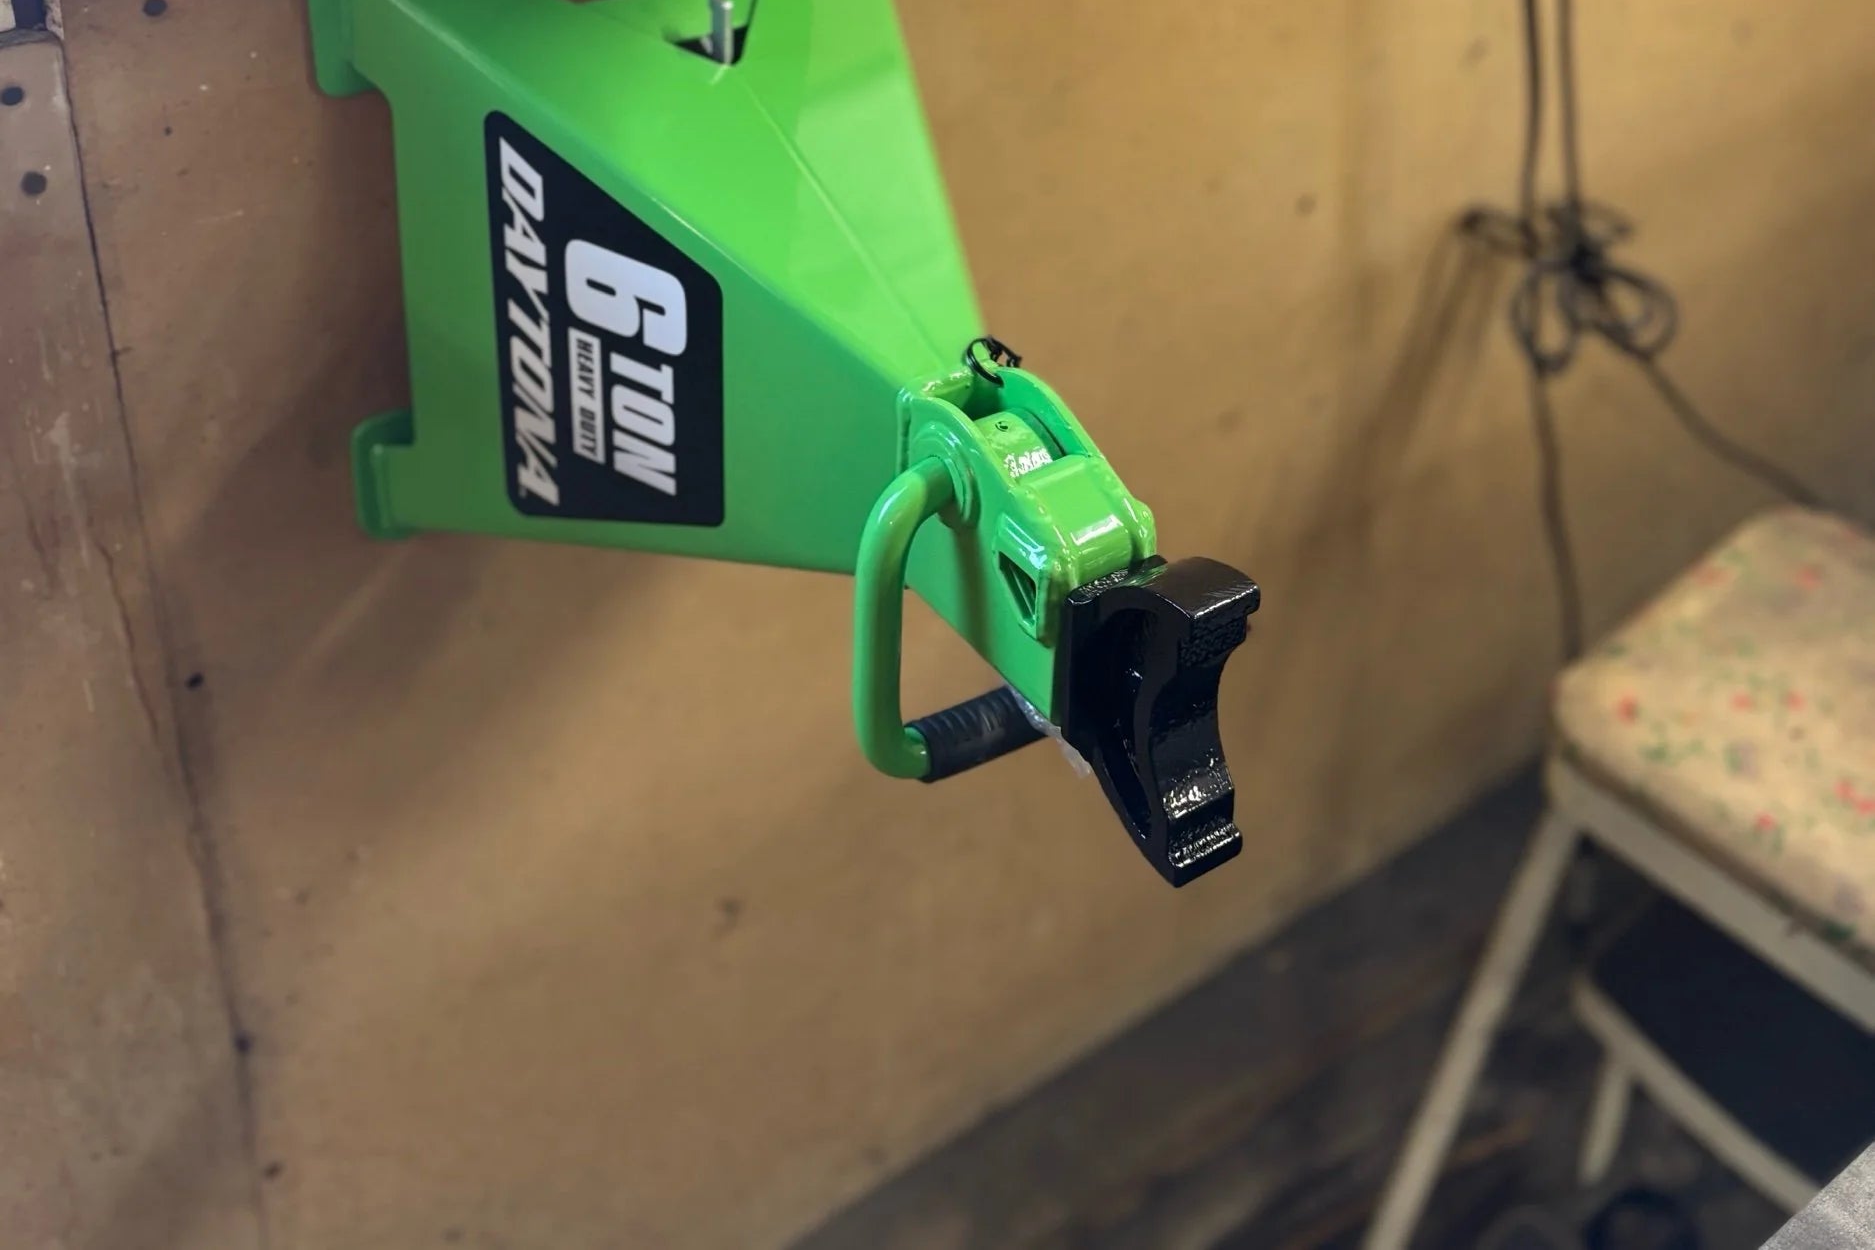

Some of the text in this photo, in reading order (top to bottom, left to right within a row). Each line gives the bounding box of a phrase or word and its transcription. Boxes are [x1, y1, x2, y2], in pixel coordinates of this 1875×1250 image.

[499, 137, 559, 507] DAYTONA
[565, 239, 688, 495] 6 TON
[576, 338, 598, 458] HEAVY DUTY
